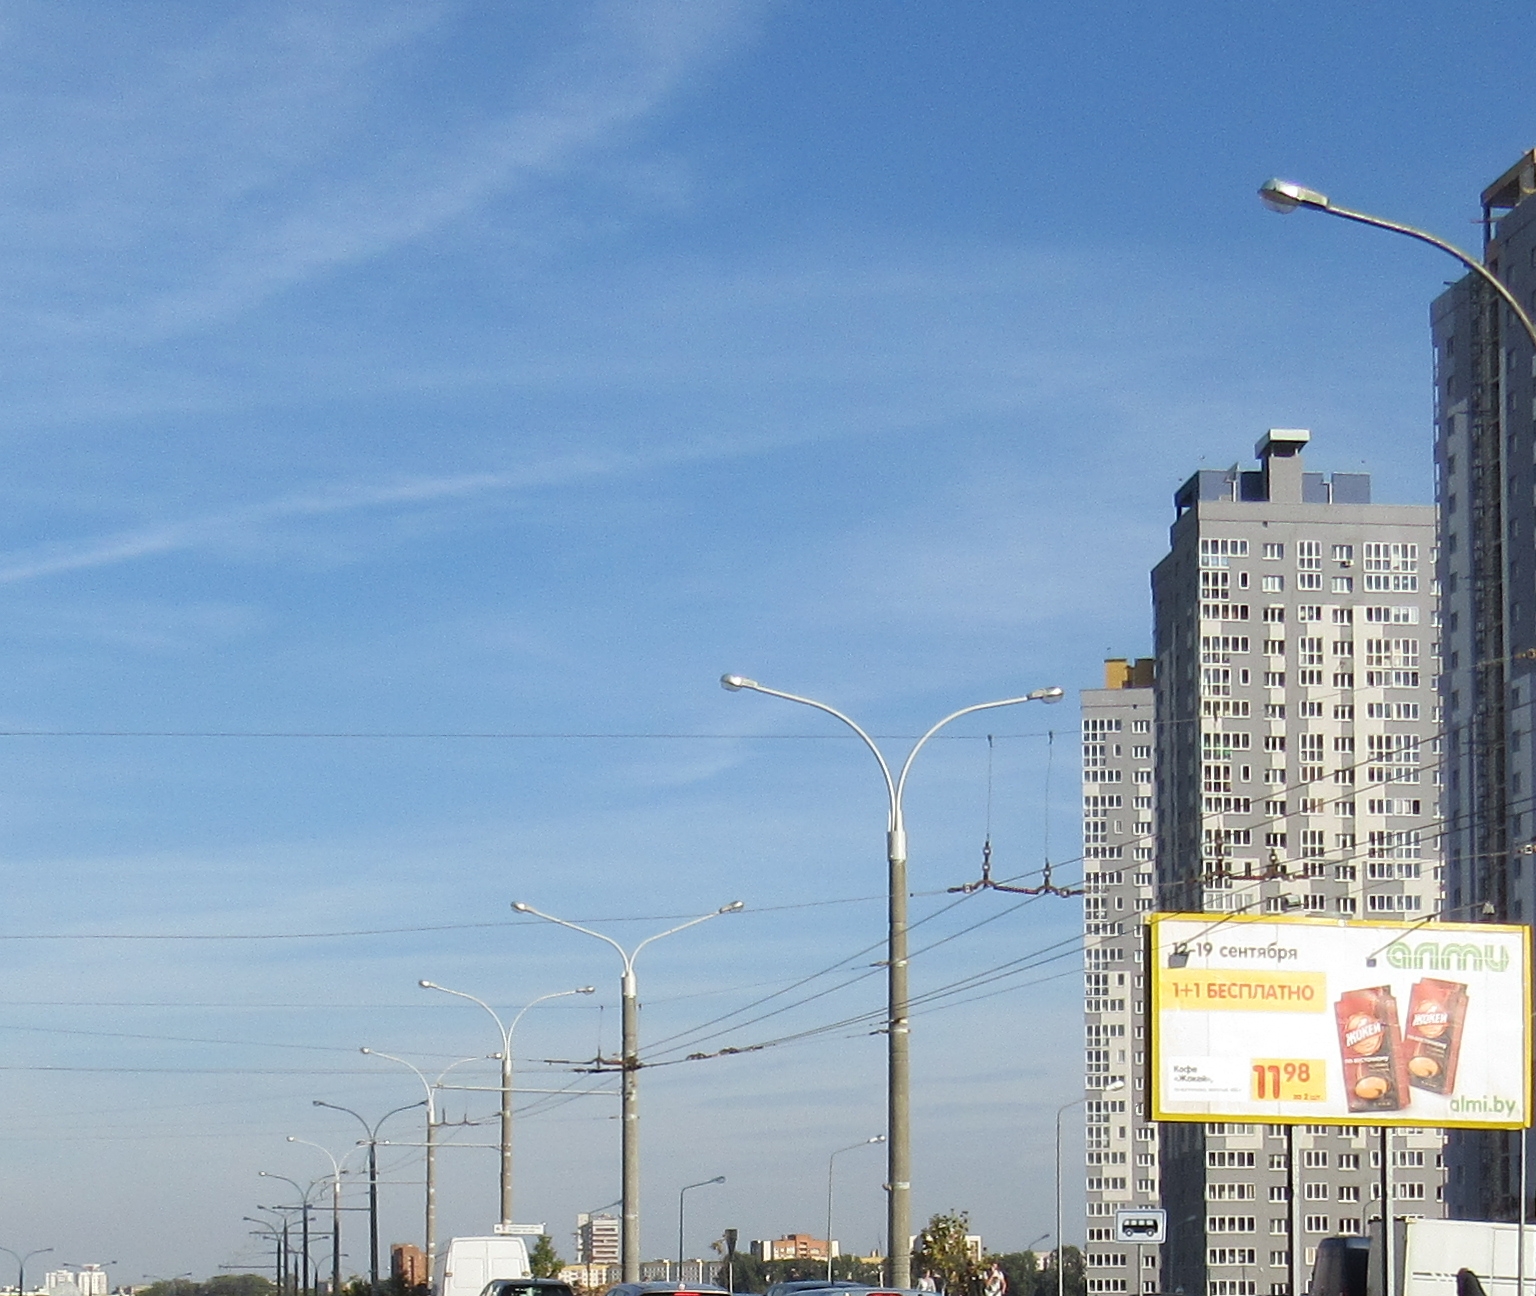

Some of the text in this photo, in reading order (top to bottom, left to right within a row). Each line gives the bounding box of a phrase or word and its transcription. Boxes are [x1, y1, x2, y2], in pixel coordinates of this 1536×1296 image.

[1219, 942, 1298, 963] сентября
[1172, 982, 1315, 1001] 1+1 БЕСПЛАТНО
[1173, 1065, 1197, 1075] Кофе
[1252, 1062, 1311, 1099] 11 98
[1450, 1095, 1516, 1117] almi.by
